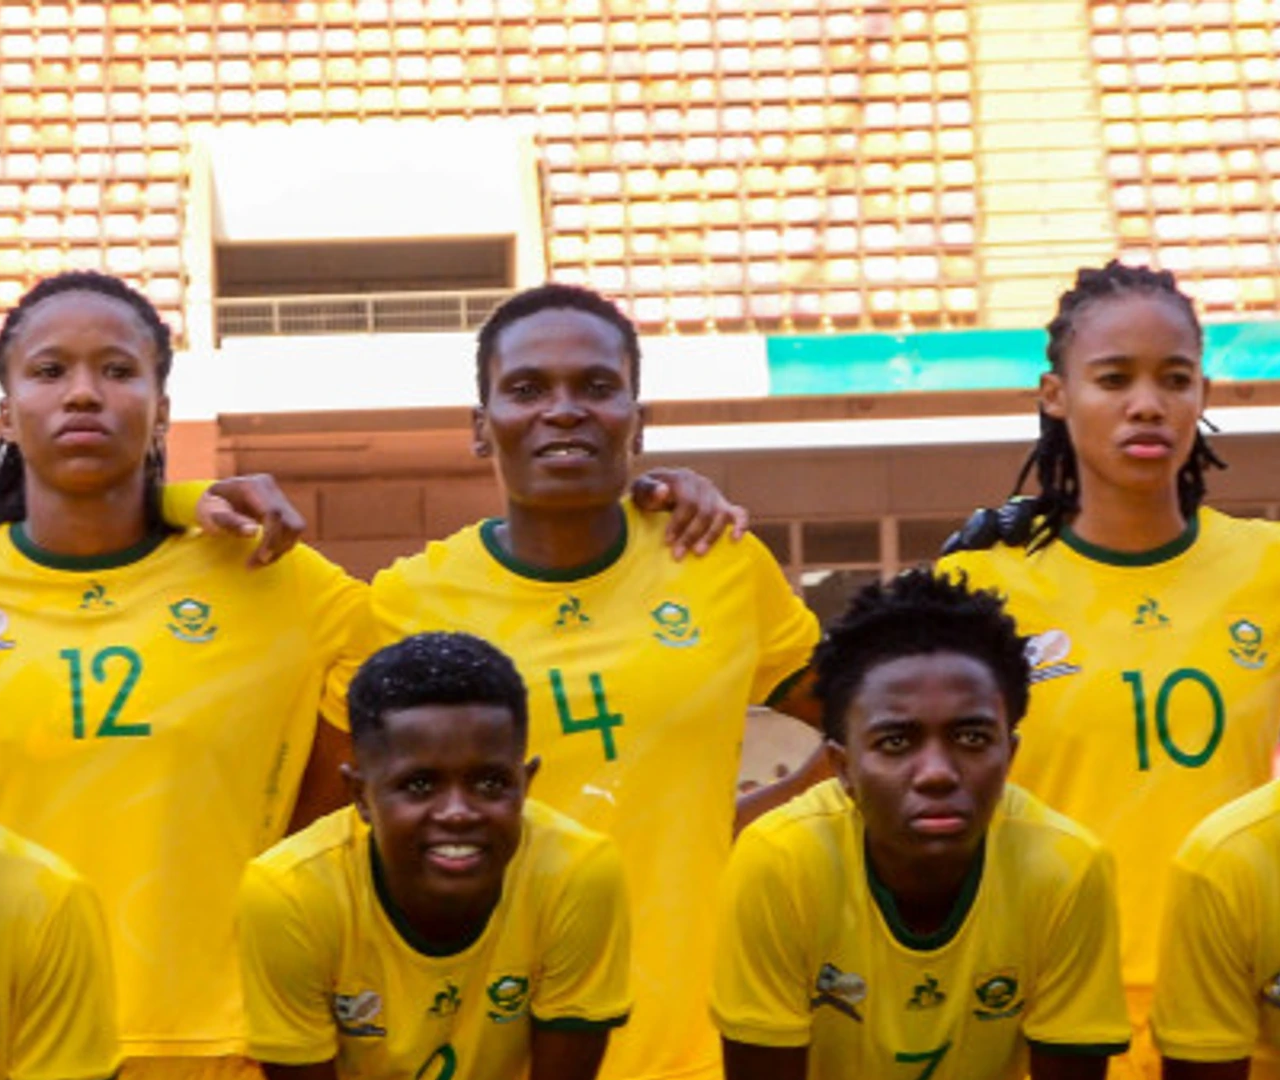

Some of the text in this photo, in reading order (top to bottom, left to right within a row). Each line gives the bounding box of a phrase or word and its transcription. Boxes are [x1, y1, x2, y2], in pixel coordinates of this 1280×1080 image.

[59, 646, 151, 740] 12
[549, 668, 624, 761] 4
[1122, 667, 1226, 771] 10
